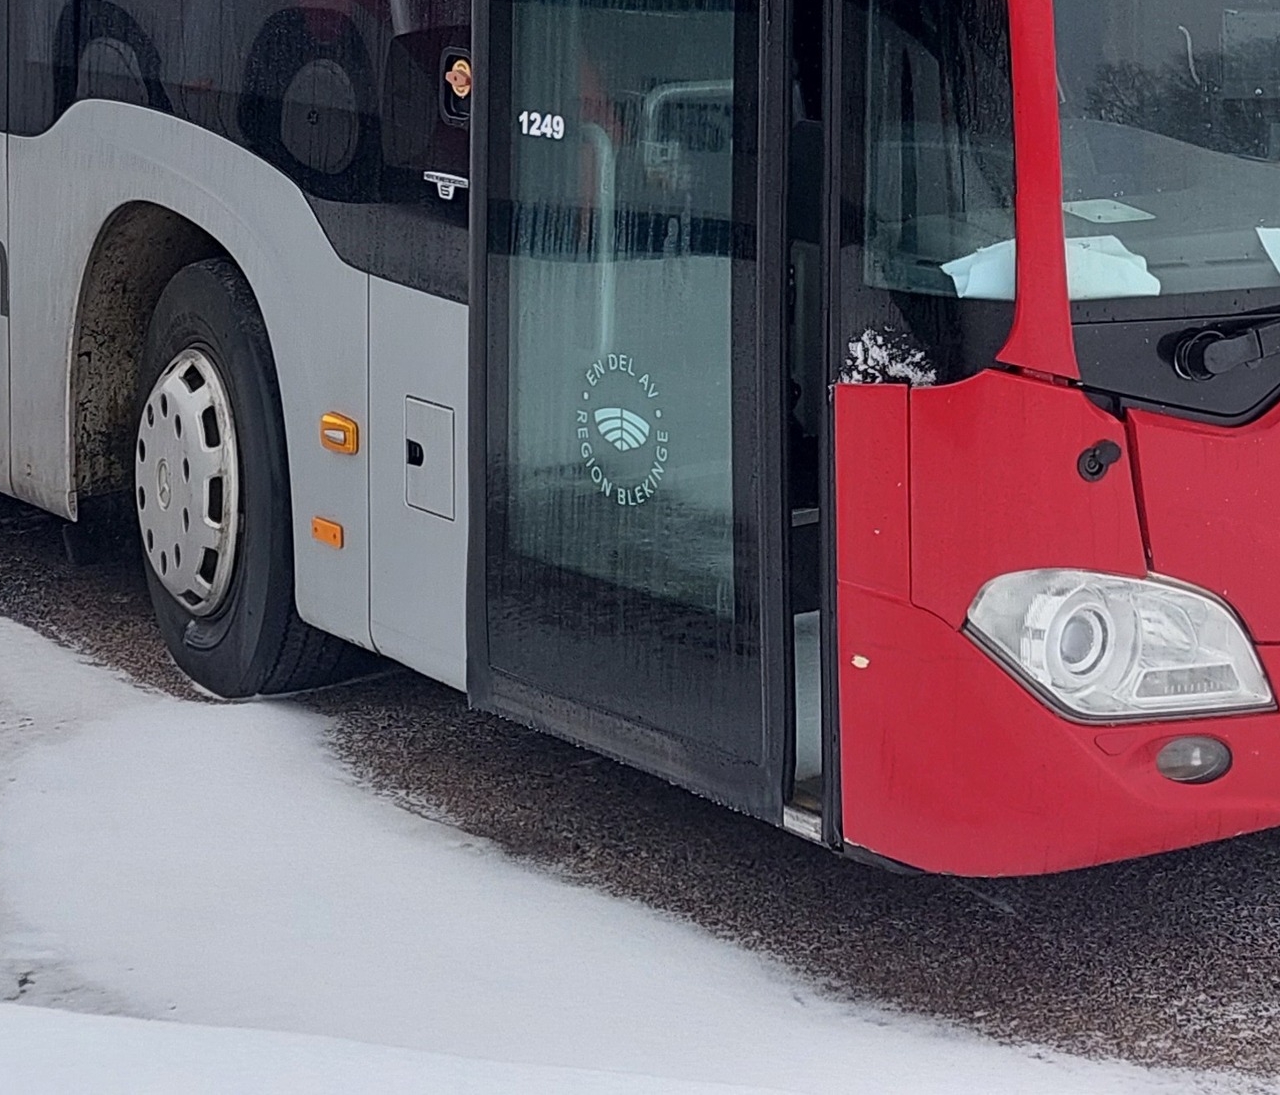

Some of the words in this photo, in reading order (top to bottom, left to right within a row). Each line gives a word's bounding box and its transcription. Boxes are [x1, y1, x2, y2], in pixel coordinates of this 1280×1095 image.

[518, 110, 565, 140] 1249
[585, 359, 606, 387] EN
[607, 353, 636, 377] DEL
[638, 373, 660, 399] AV
[576, 409, 613, 498] REGION
[617, 429, 669, 506] BLEKINGE
